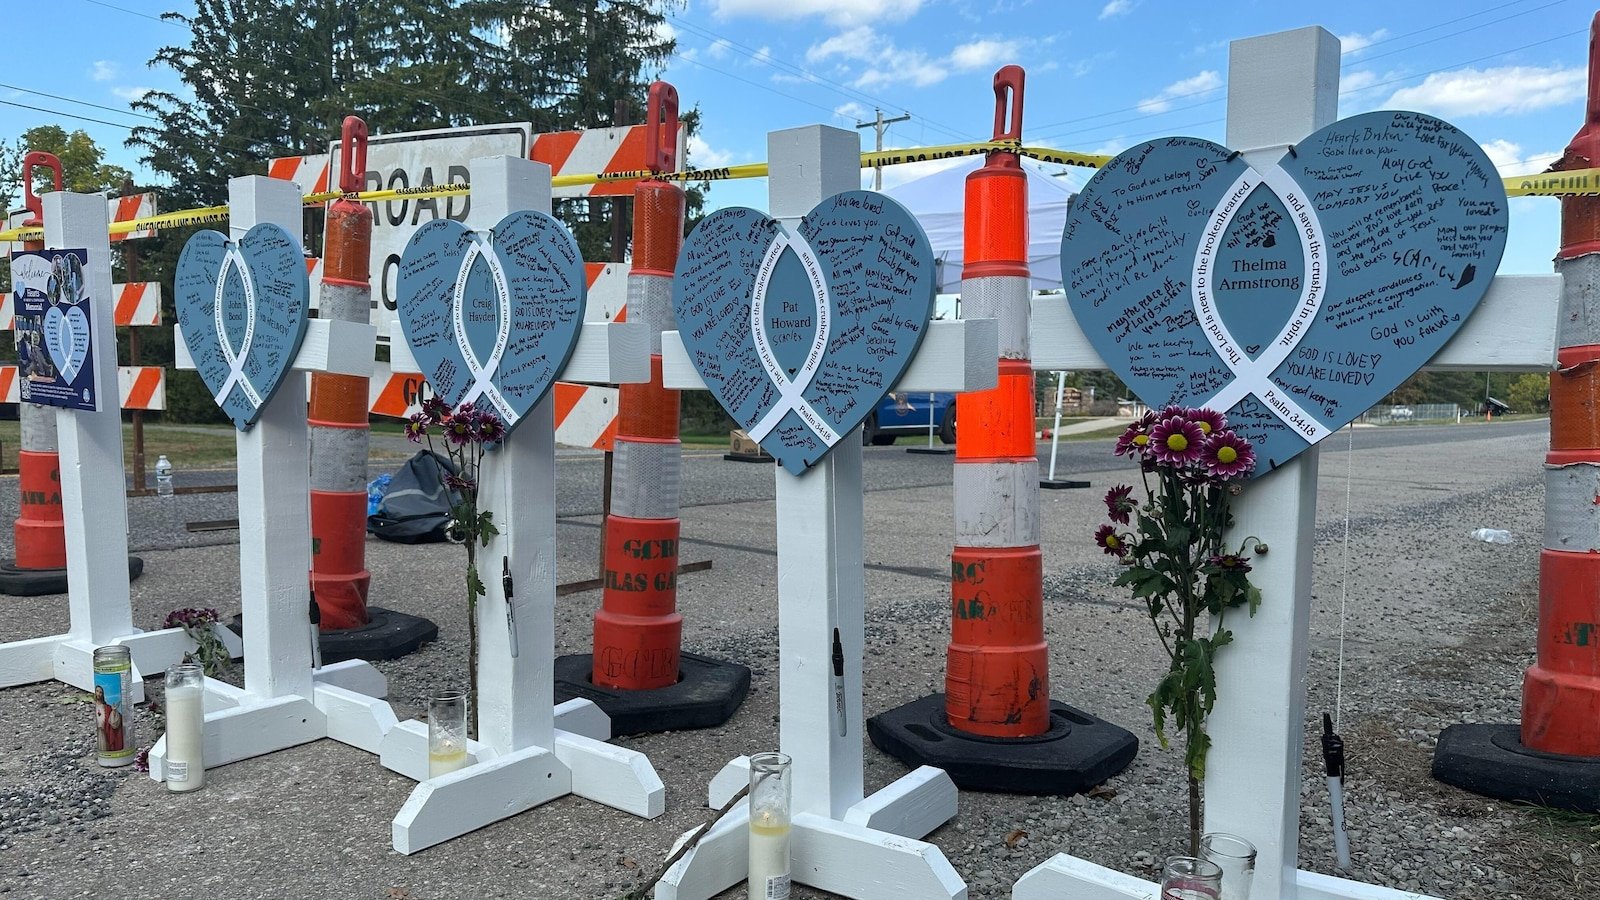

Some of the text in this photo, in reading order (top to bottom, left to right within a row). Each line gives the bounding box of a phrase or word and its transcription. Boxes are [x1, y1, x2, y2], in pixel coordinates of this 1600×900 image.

[1381, 155, 1433, 171] May God
[1128, 178, 1147, 192] God
[1164, 170, 1191, 182] belong
[1171, 182, 1202, 195] return
[1313, 182, 1388, 202] MAY JESUS
[1317, 188, 1400, 211] COMFORT YOU
[1197, 180, 1251, 366] The Lord is near to the brokenhearted
[1231, 259, 1287, 273] Thelma
[1279, 192, 1321, 347] and saves the crushed in spirit.
[1219, 276, 1300, 291] Armstrong
[472, 298, 492, 311] Craig
[782, 301, 798, 313] Pat
[1327, 301, 1343, 312] Our
[1345, 288, 1376, 305] deepest
[469, 312, 496, 323] Hayden
[771, 316, 811, 329] Howard
[1370, 323, 1400, 341] God
[1127, 341, 1143, 351] We
[1299, 346, 1369, 368] GOD IS LOVE
[1190, 371, 1208, 381] May
[1287, 361, 1362, 386] YOU ARE LOVED
[799, 405, 817, 429] Psalm
[1264, 390, 1316, 437] Psalm 34:18
